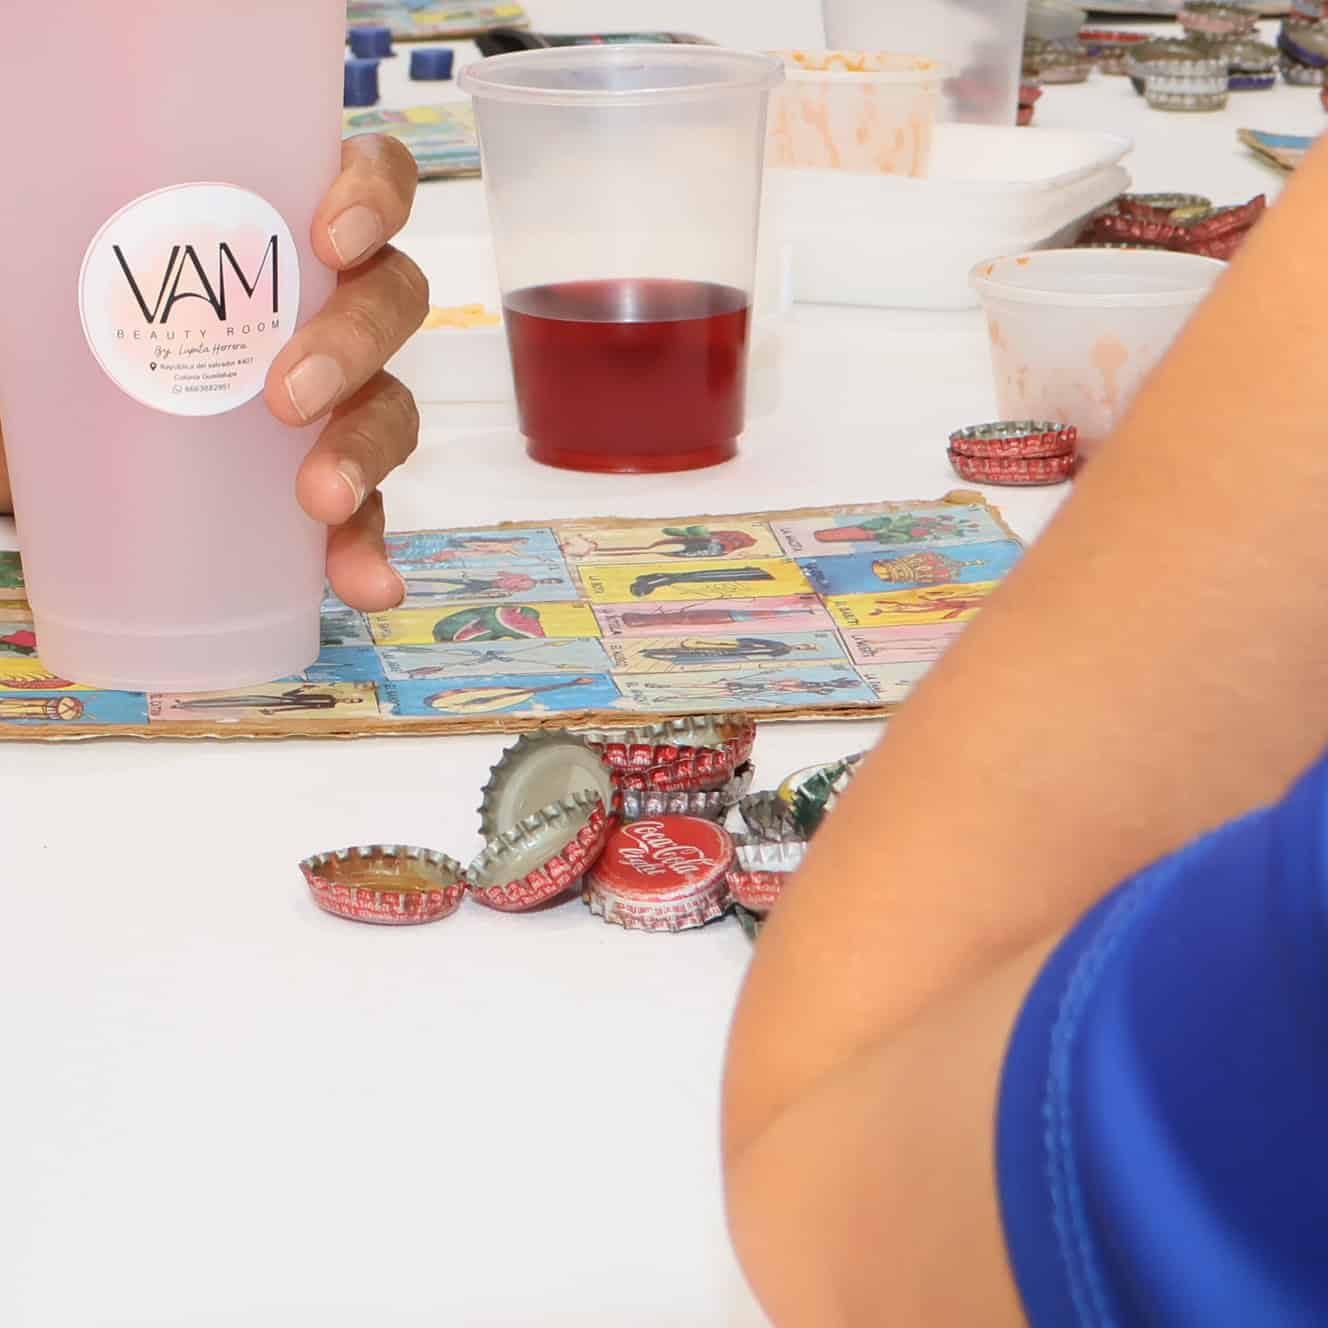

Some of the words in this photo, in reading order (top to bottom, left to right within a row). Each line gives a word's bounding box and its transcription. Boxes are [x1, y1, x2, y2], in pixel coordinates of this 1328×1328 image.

[112, 234, 280, 325] VAM
[116, 328, 208, 340] BEAUTY
[226, 319, 280, 337] ROOM
[154, 344, 172, 359] By
[621, 821, 716, 875] Coca-Cola
